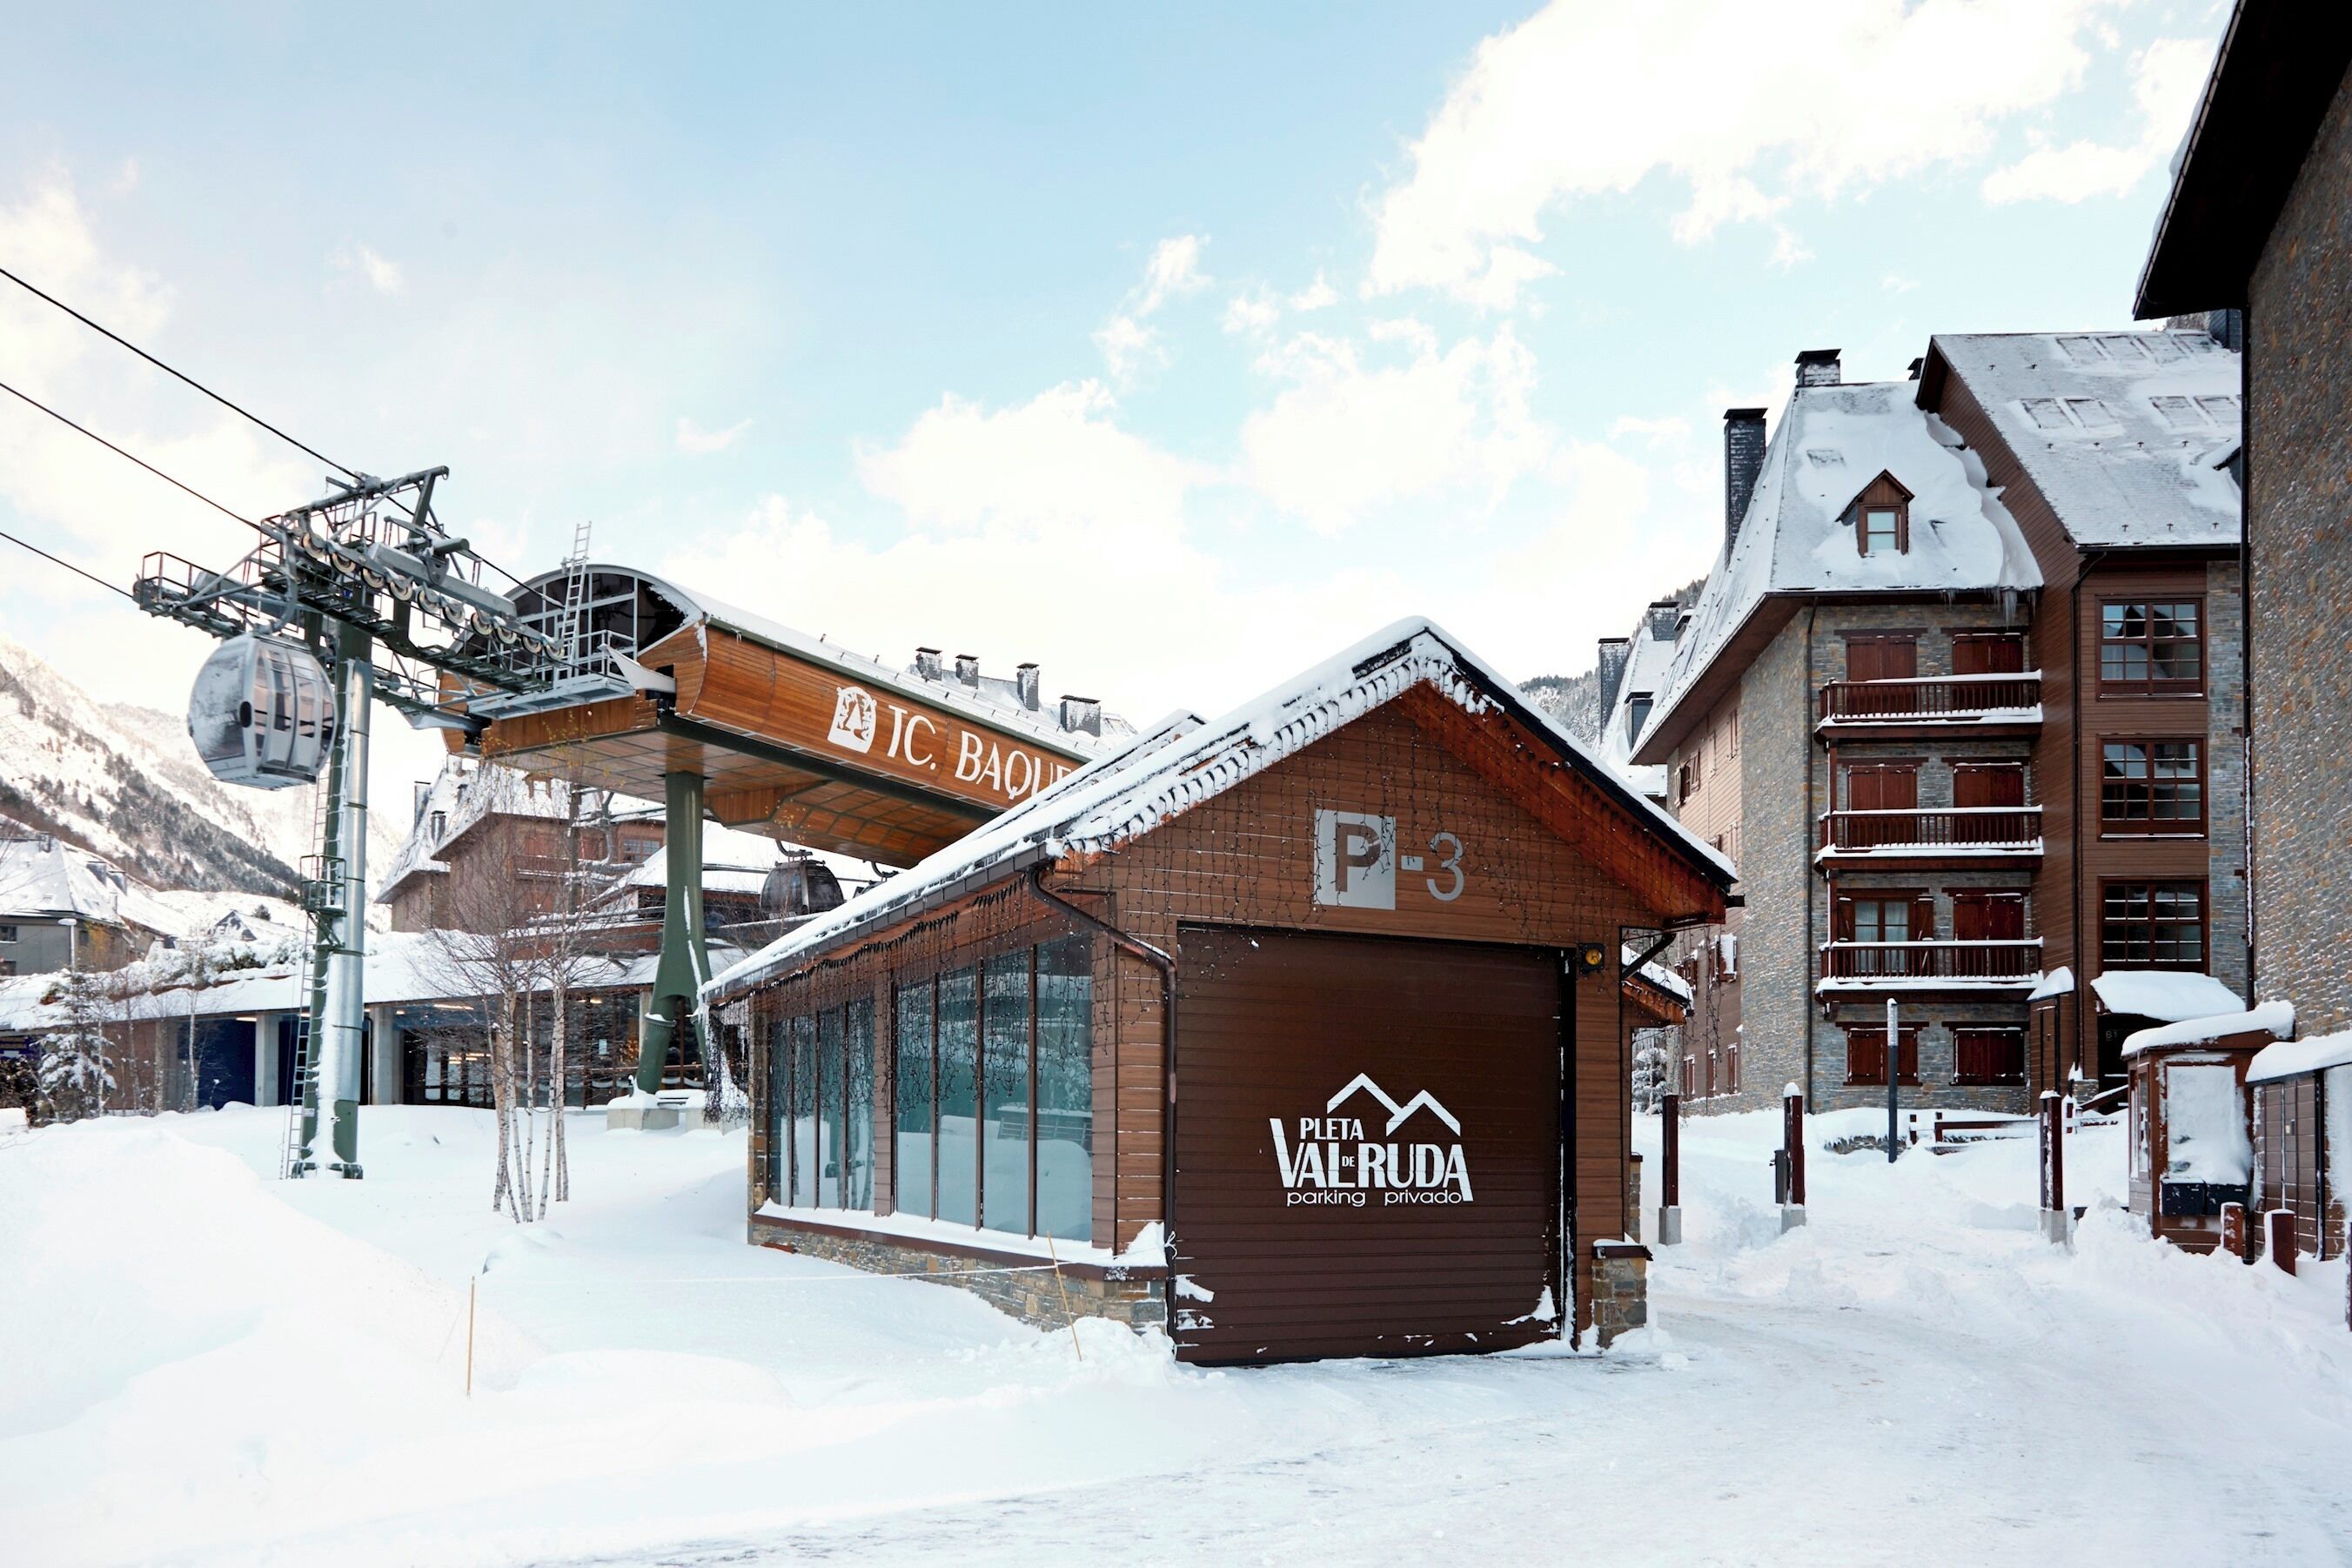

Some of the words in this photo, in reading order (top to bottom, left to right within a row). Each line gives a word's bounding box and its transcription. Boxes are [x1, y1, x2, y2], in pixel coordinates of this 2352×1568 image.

[888, 705, 936, 770] TC.
[1300, 1117, 1364, 1140] PLETA
[1270, 1117, 1356, 1188] VAL
[1342, 1156, 1355, 1167] DE
[1357, 1142, 1473, 1202] RUDA
[1286, 1189, 1366, 1207] parking
[1384, 1189, 1463, 1206] privado
